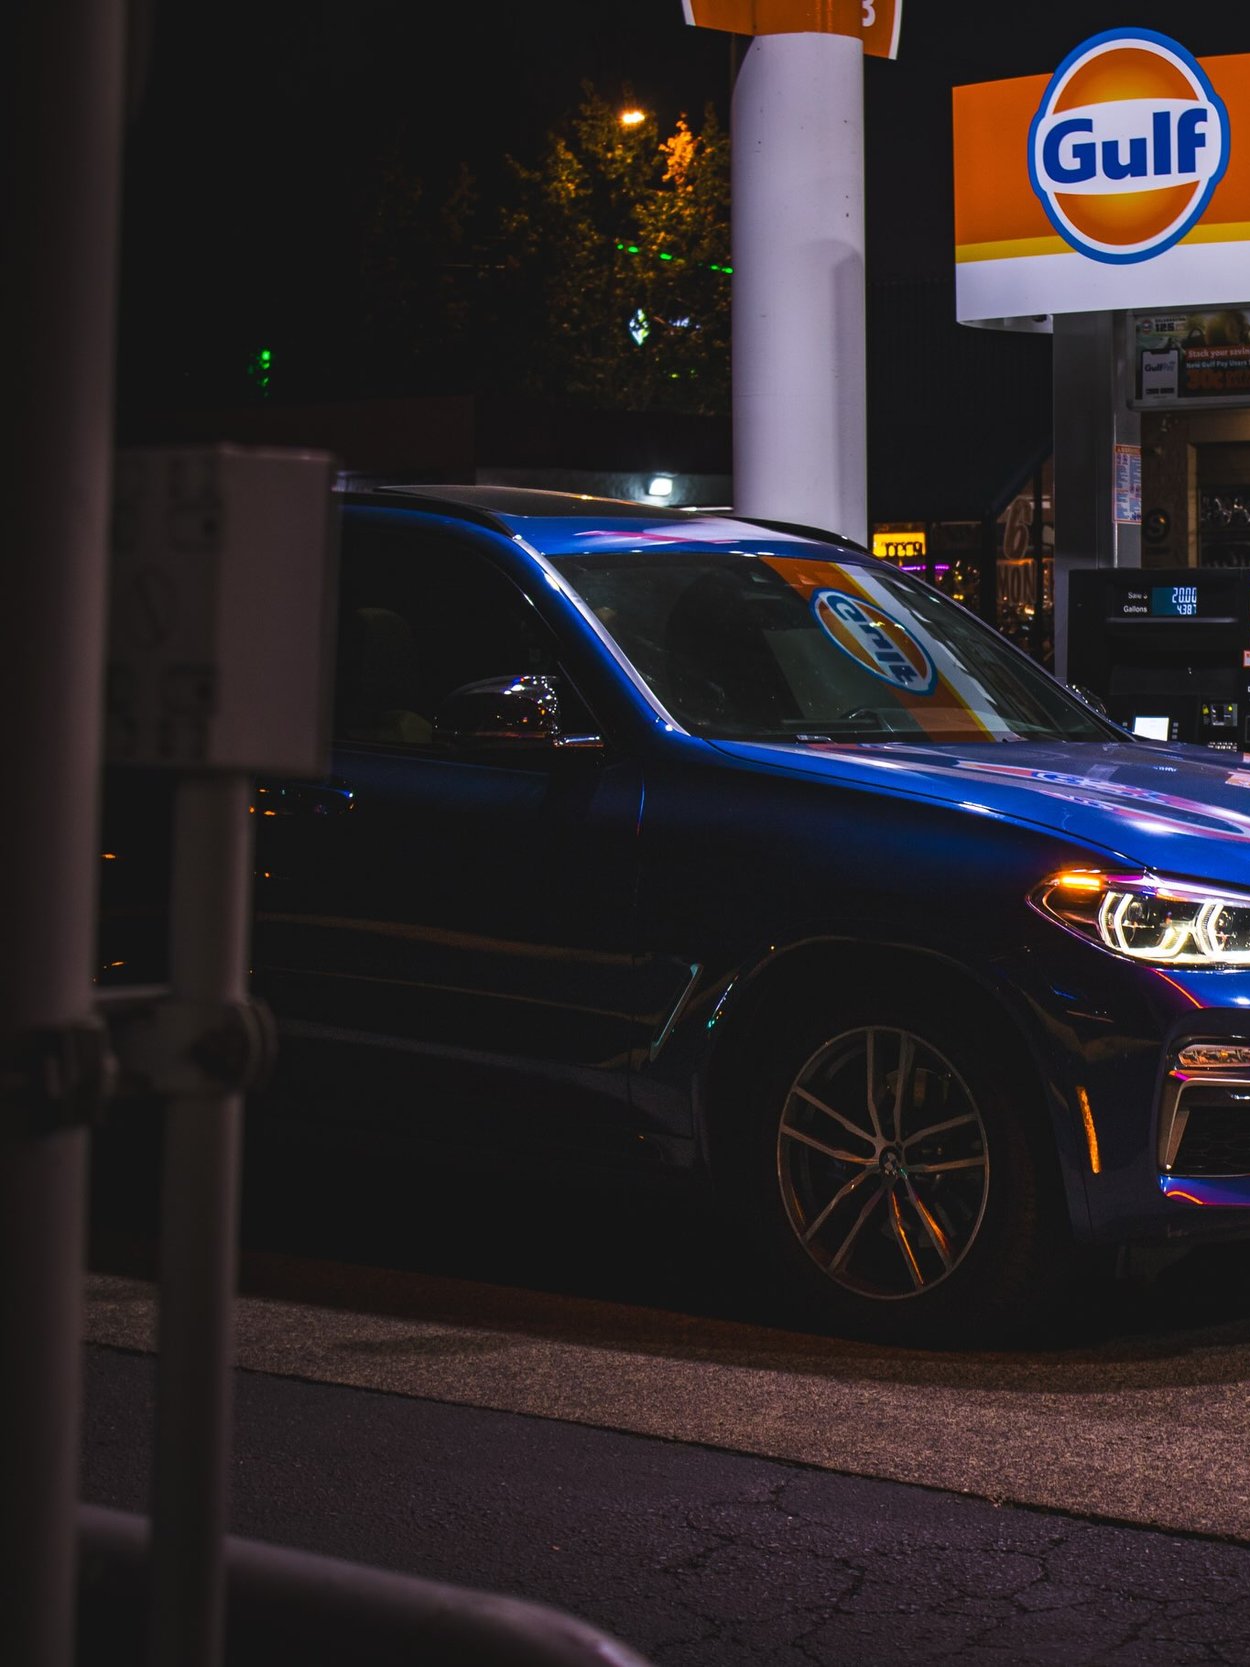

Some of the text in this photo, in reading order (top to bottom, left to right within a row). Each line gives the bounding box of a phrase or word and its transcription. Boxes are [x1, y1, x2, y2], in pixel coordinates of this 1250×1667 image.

[1042, 107, 1208, 184] Gulf
[1188, 349, 1210, 358] Stack
[1210, 349, 1228, 359] your
[1123, 605, 1148, 613] Gallons
